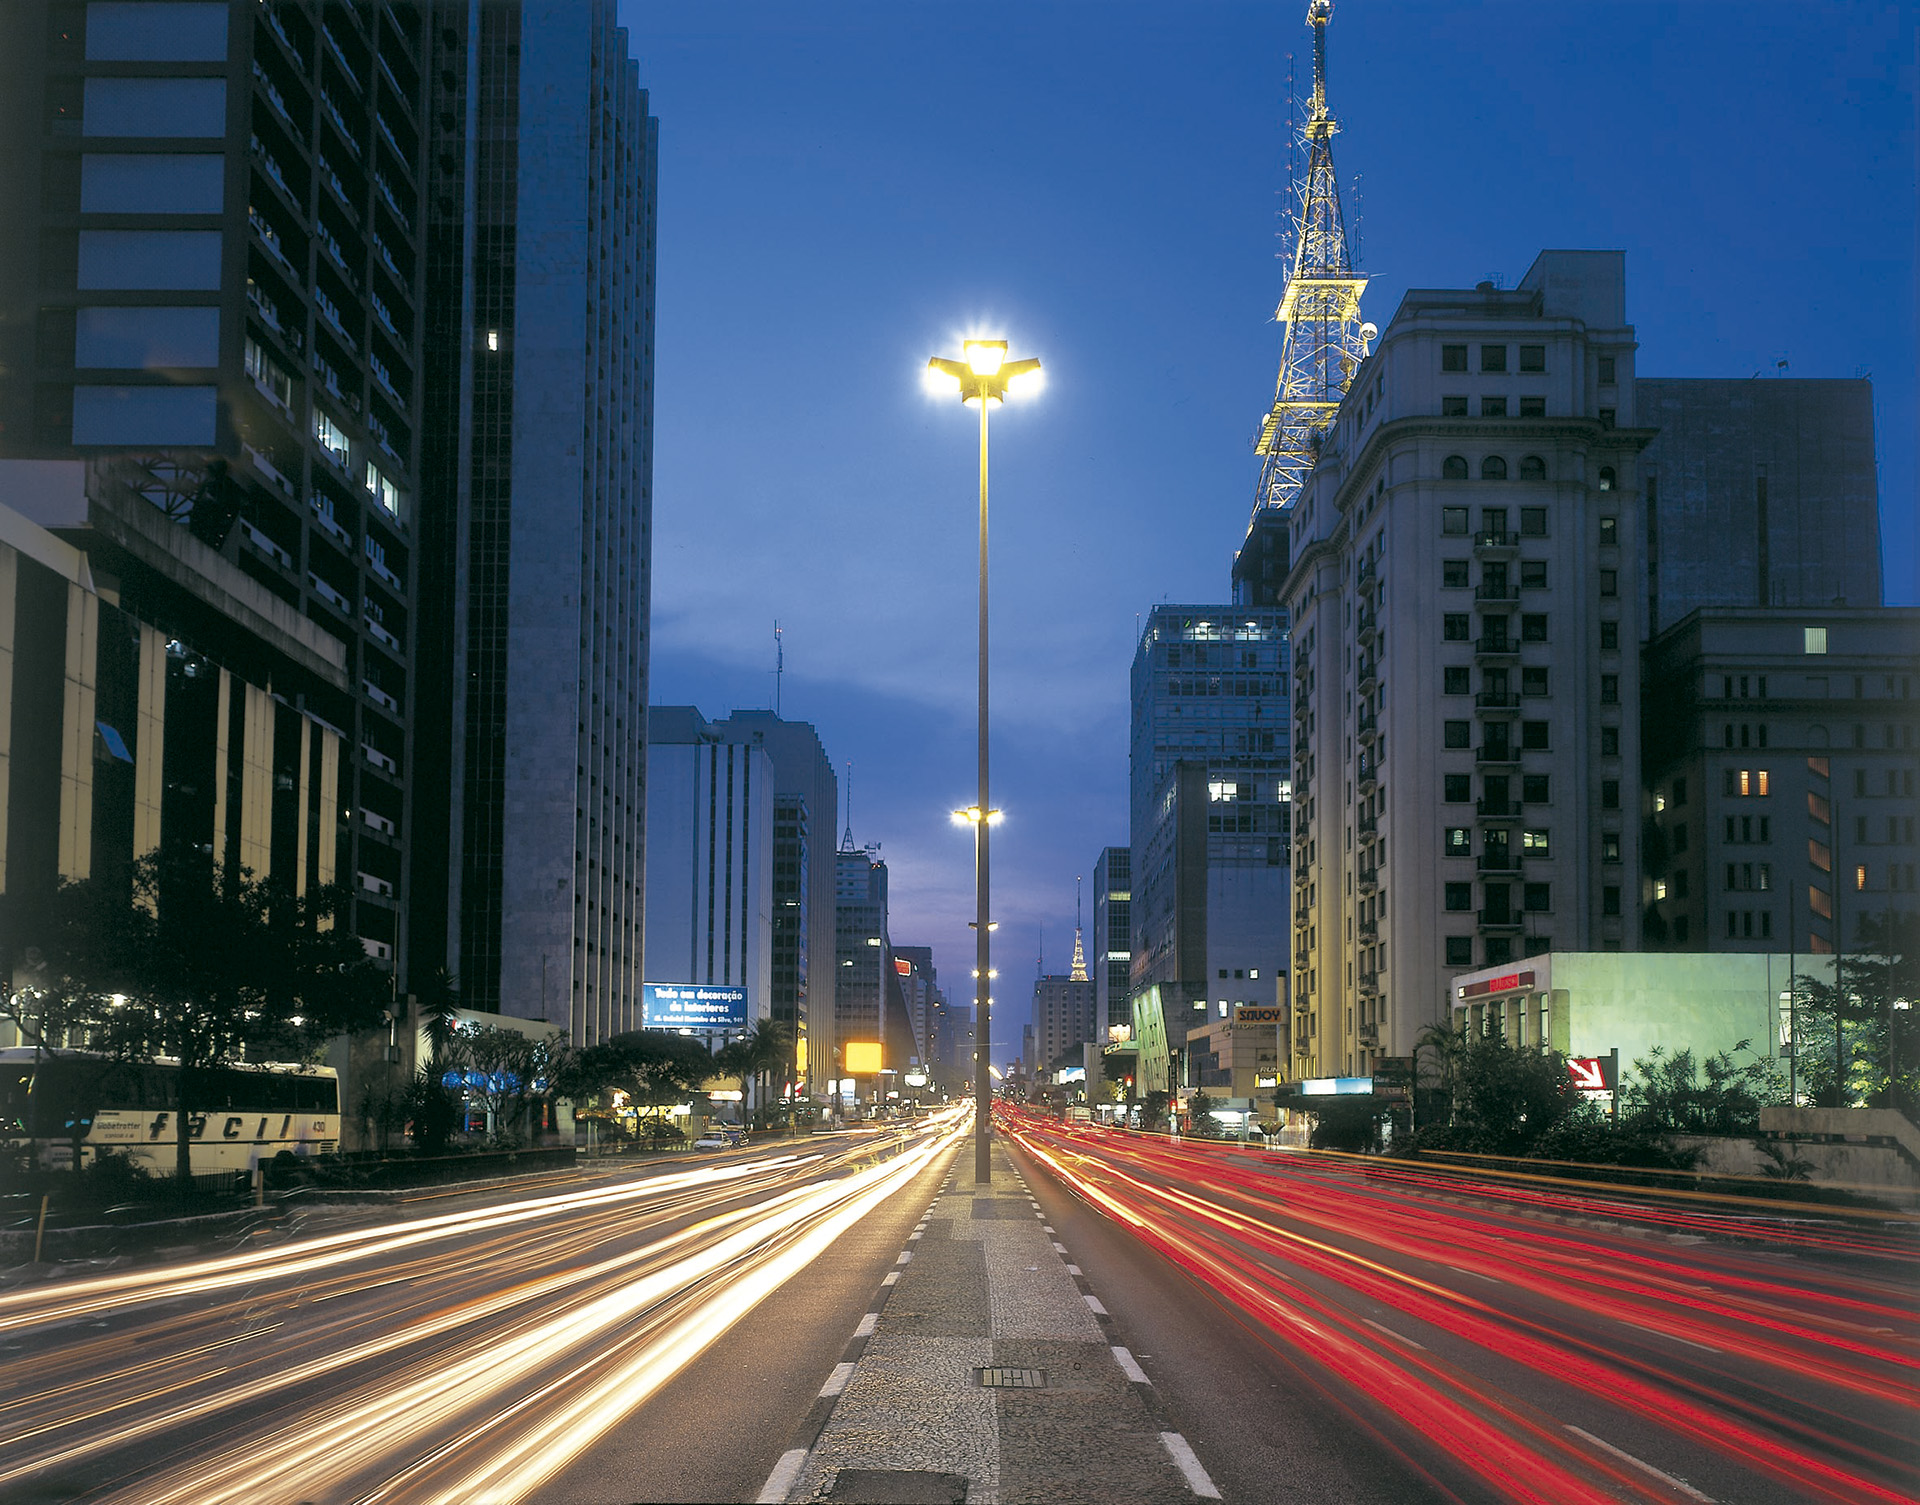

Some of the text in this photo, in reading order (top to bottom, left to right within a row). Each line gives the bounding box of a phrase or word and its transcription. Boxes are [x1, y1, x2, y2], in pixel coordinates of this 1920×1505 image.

[697, 988, 743, 1002] decoração
[684, 1001, 729, 1012] interiores
[1239, 1010, 1280, 1020] SAVOY
[97, 1122, 142, 1130] Globetrotter
[312, 1121, 326, 1133] 430
